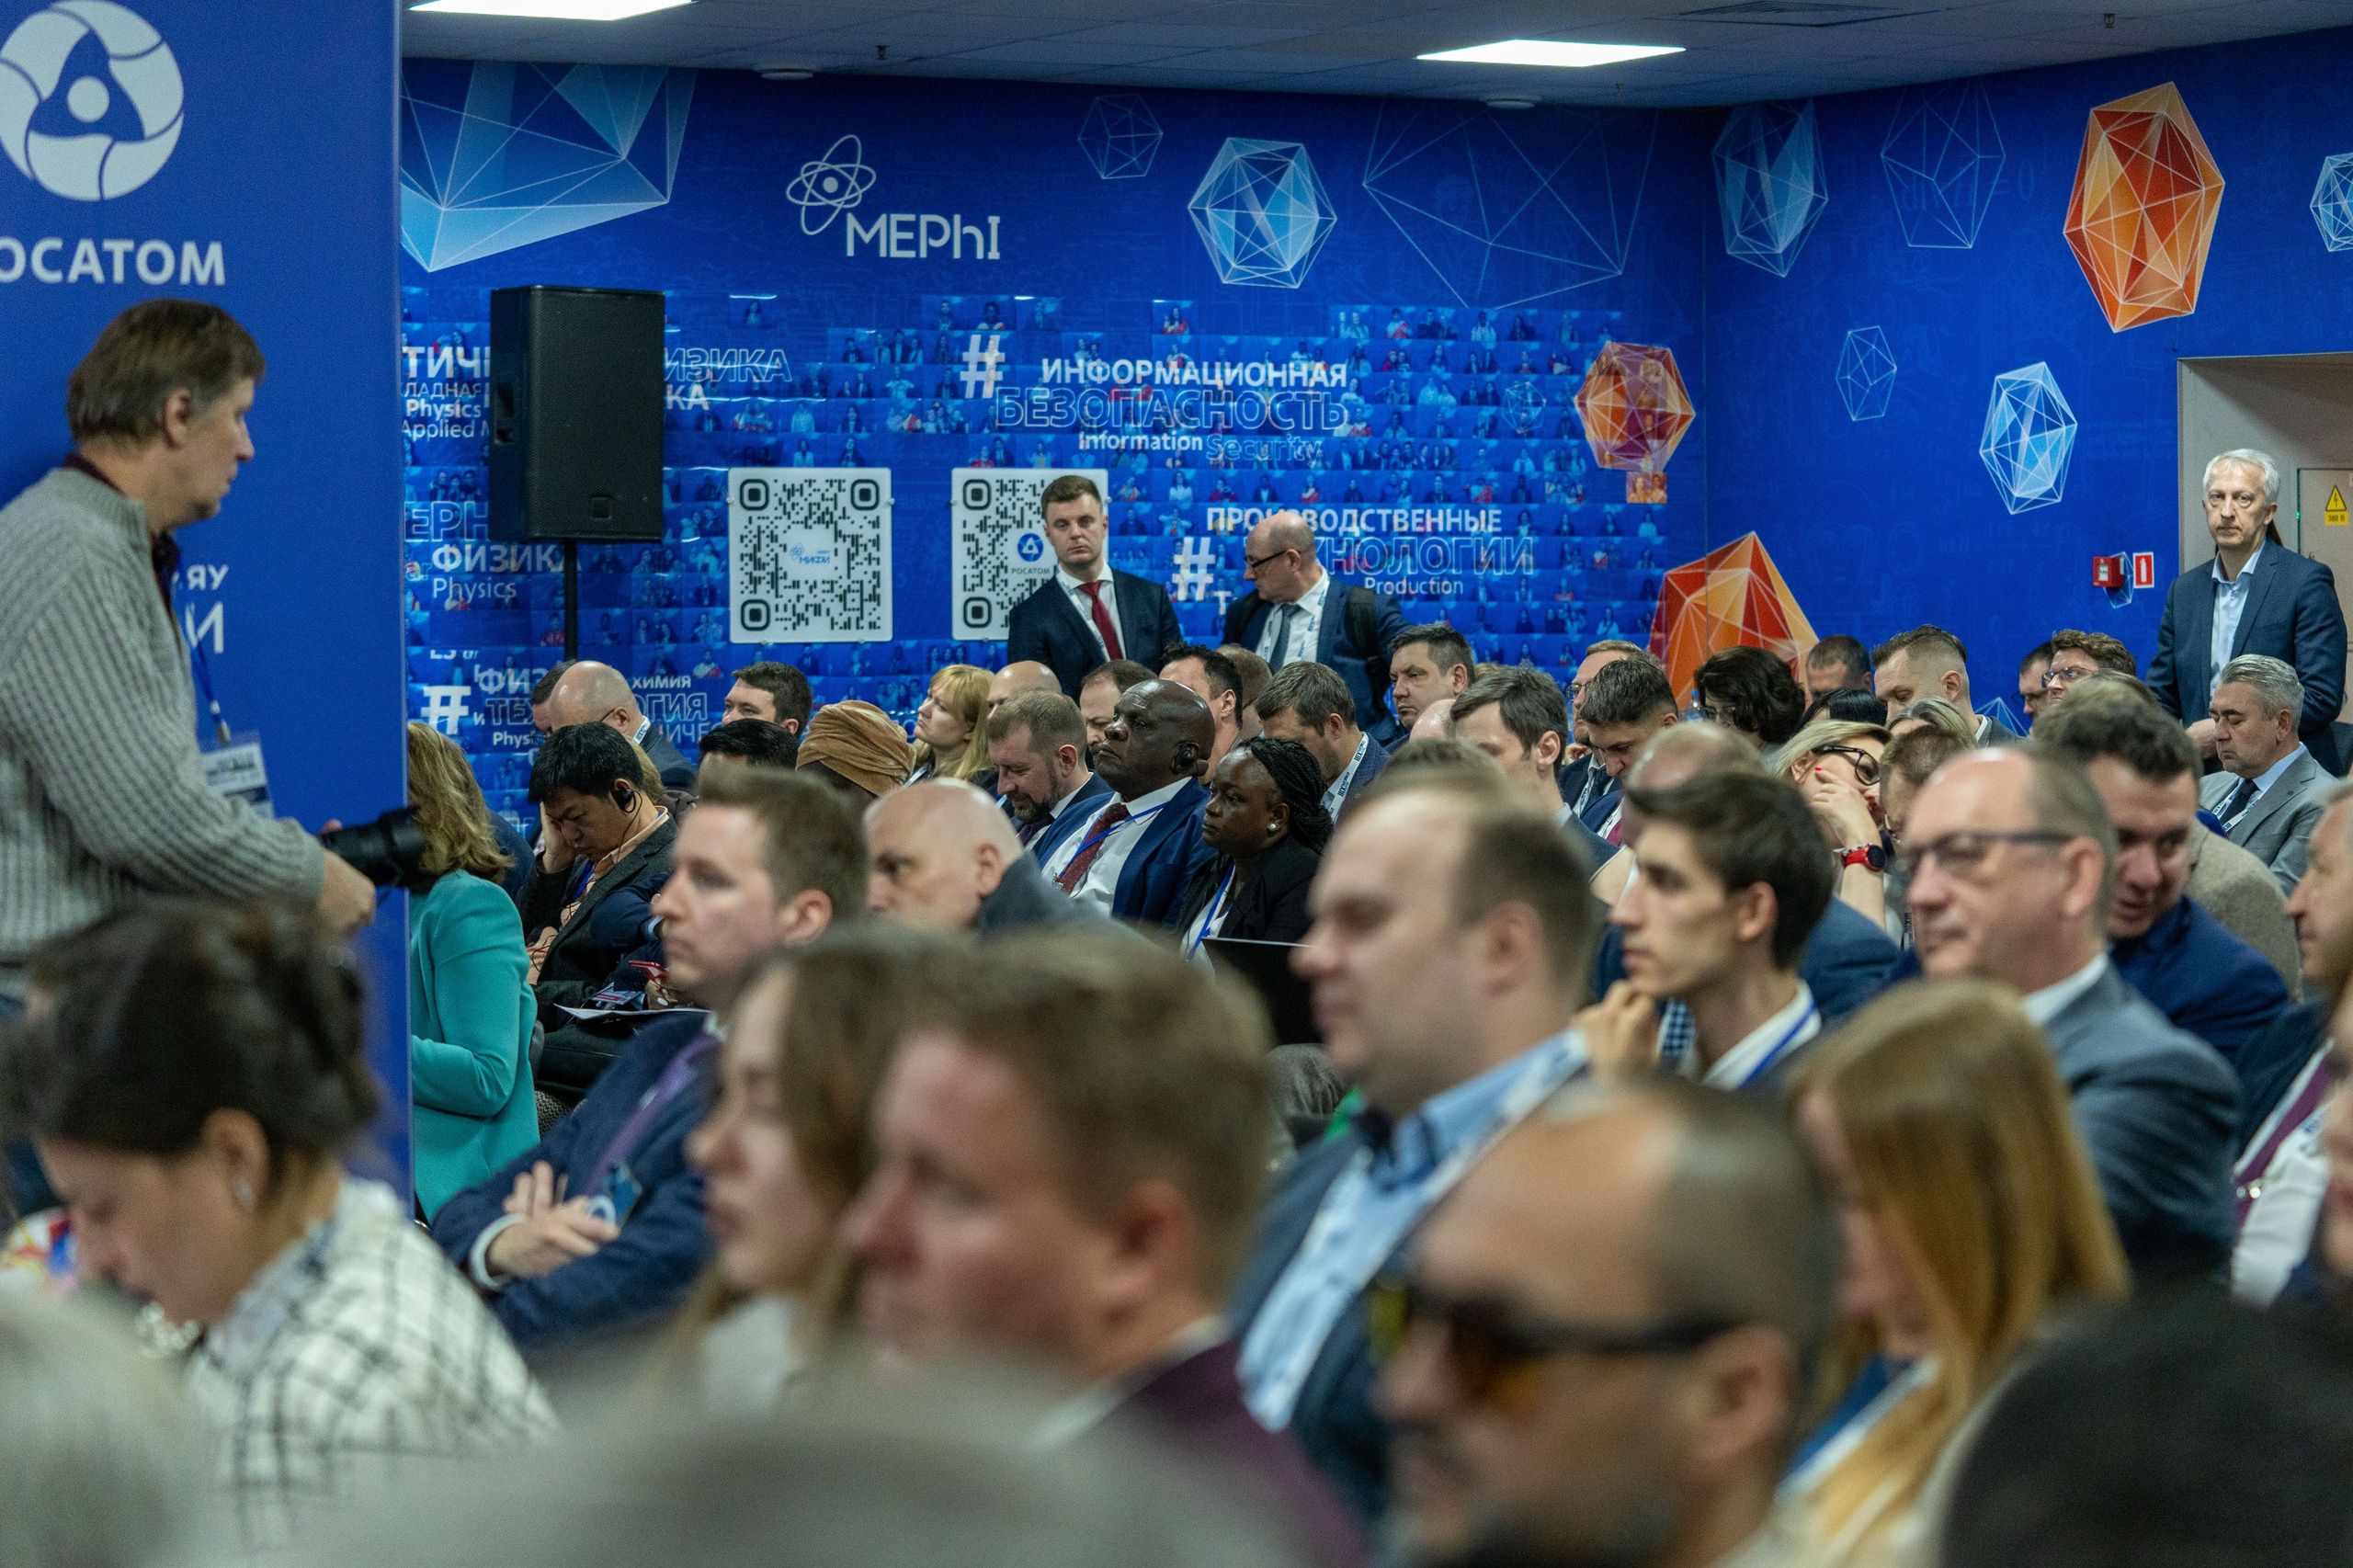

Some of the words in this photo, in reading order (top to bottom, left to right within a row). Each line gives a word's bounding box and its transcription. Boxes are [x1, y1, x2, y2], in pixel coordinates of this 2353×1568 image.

[846, 212, 1001, 260] MEPhI
[1041, 358, 1347, 388] ИНФОРМАЦИОННАЯ
[402, 382, 482, 400] ЛАДНАЯ
[406, 398, 482, 421] Physics
[995, 387, 1348, 430] БЕЗОПАСНОСТЬ
[402, 419, 474, 441] Applied
[1079, 430, 1203, 450] Information
[1206, 433, 1323, 468] Security
[1207, 507, 1502, 536] ПРОВОДСТВЕННЫЕ
[433, 576, 517, 603] Physics
[1364, 576, 1463, 595] Production
